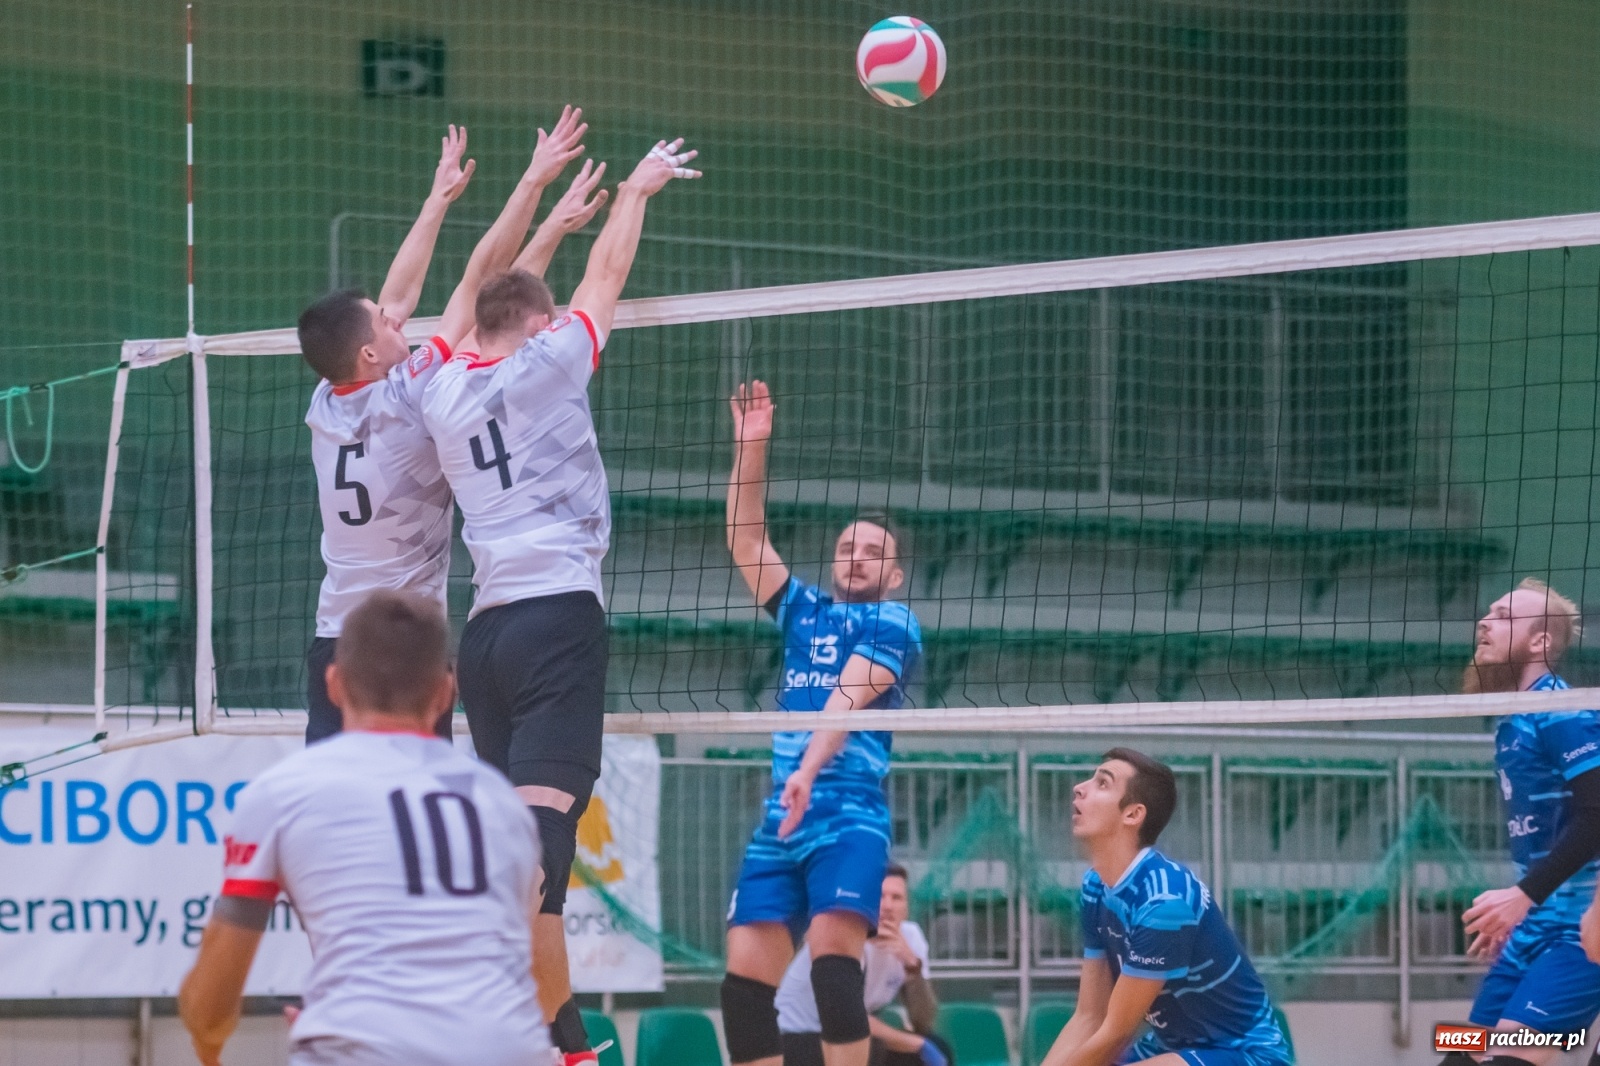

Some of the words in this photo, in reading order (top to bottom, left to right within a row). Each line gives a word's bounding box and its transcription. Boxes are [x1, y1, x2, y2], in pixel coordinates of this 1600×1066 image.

[469, 418, 513, 490] 4
[335, 441, 373, 526] 5
[810, 634, 839, 665] 13
[784, 668, 840, 691] Sene
[389, 786, 488, 896] 10
[1128, 950, 1165, 965] Senetic
